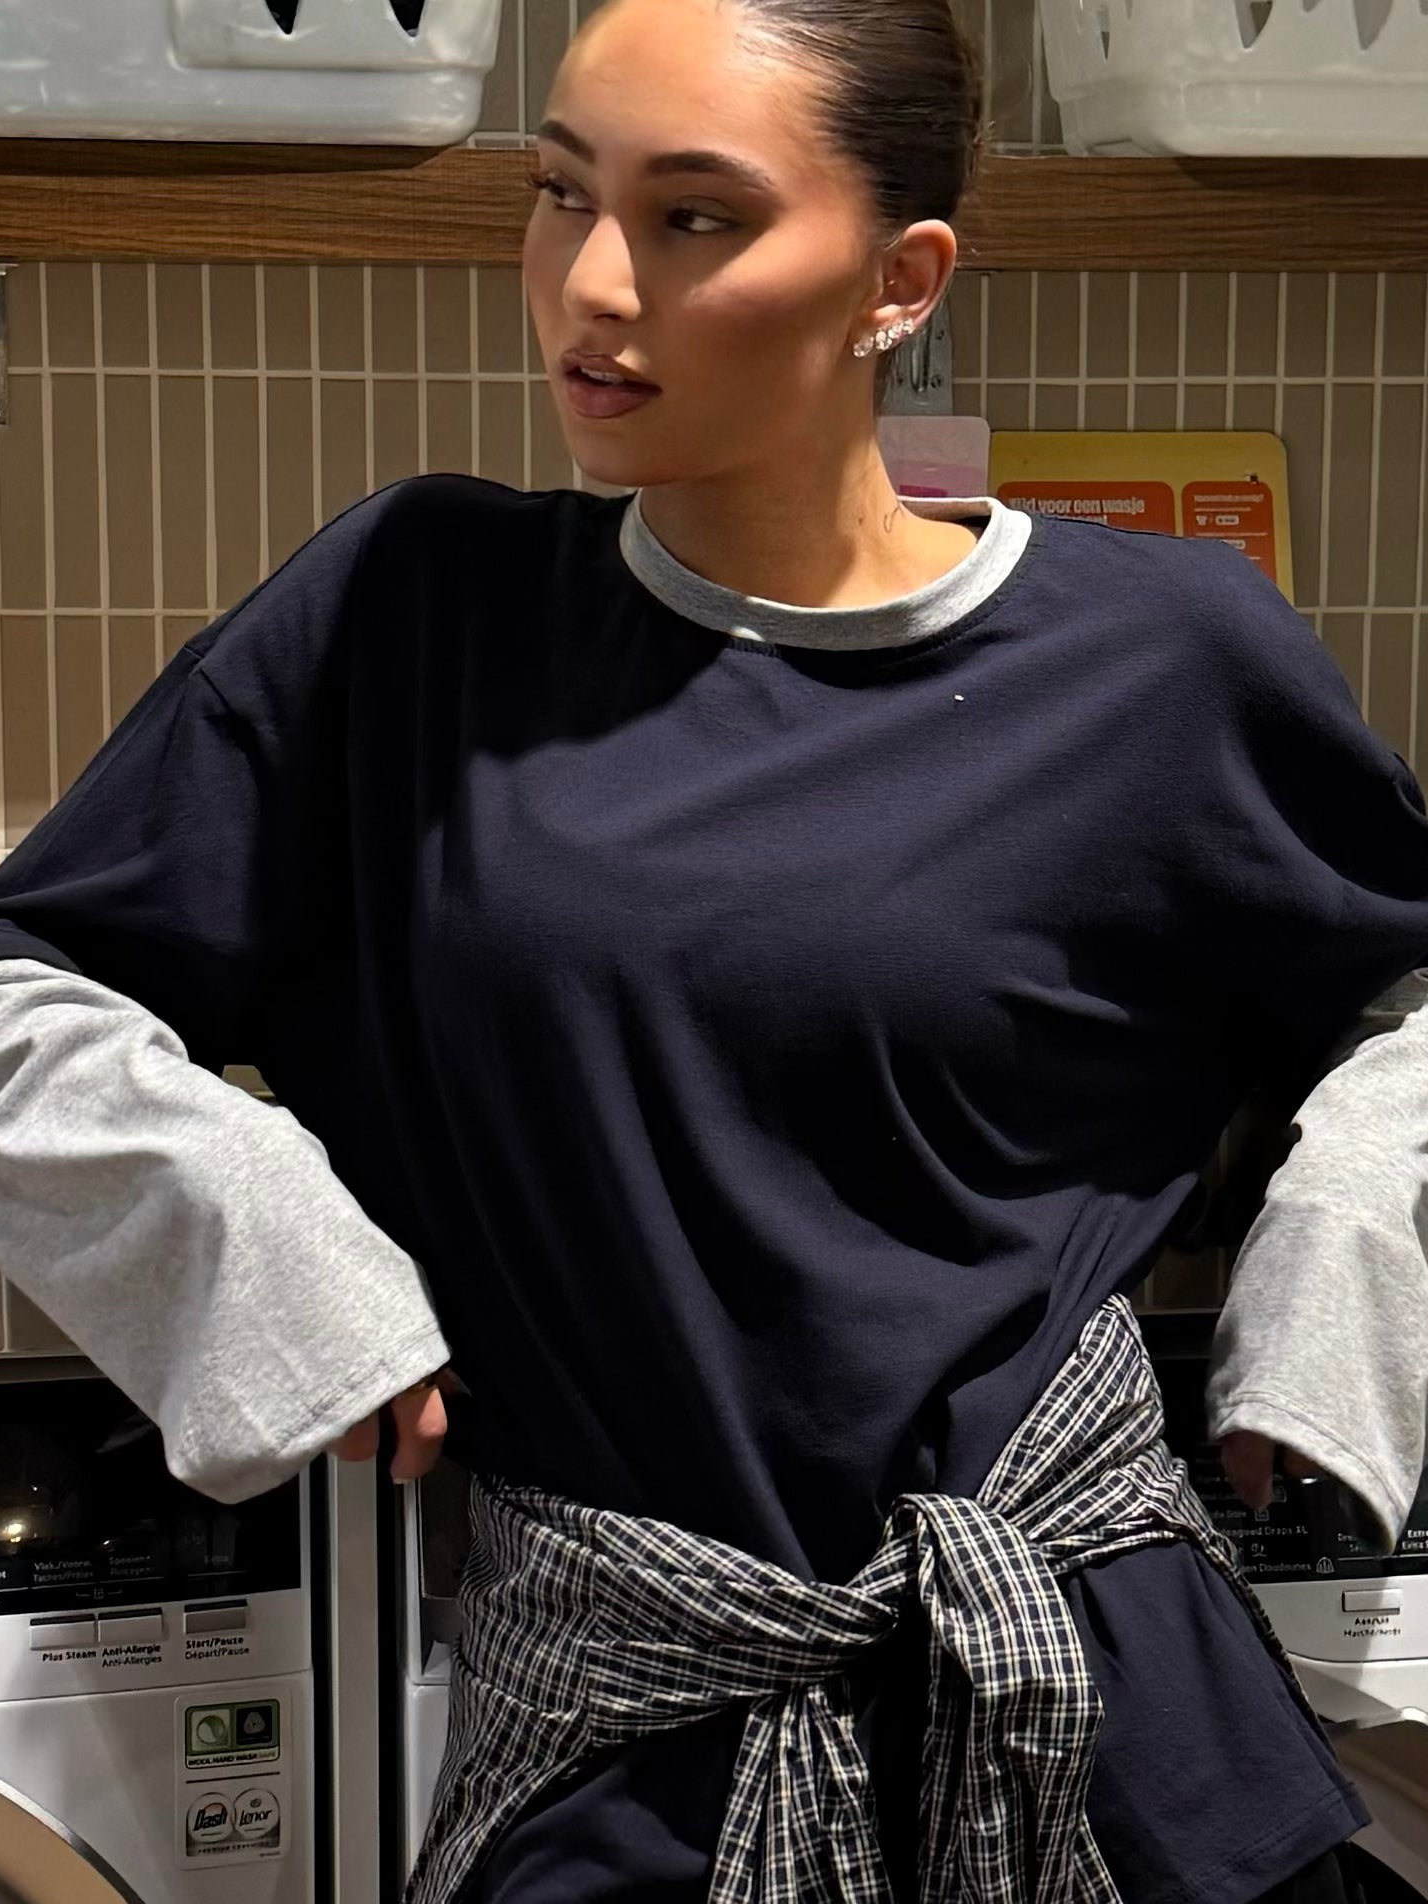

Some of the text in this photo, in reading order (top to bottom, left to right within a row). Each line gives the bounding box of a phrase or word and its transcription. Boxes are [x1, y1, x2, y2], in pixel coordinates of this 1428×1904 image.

[1038, 497, 1072, 515] voor
[1073, 497, 1101, 514] een
[1102, 496, 1145, 516] wasje
[42, 1650, 97, 1663] Plus Steam
[102, 1644, 161, 1658] Anti-Allergie
[193, 1807, 228, 1832] Dash
[239, 1809, 273, 1827] Lenor
